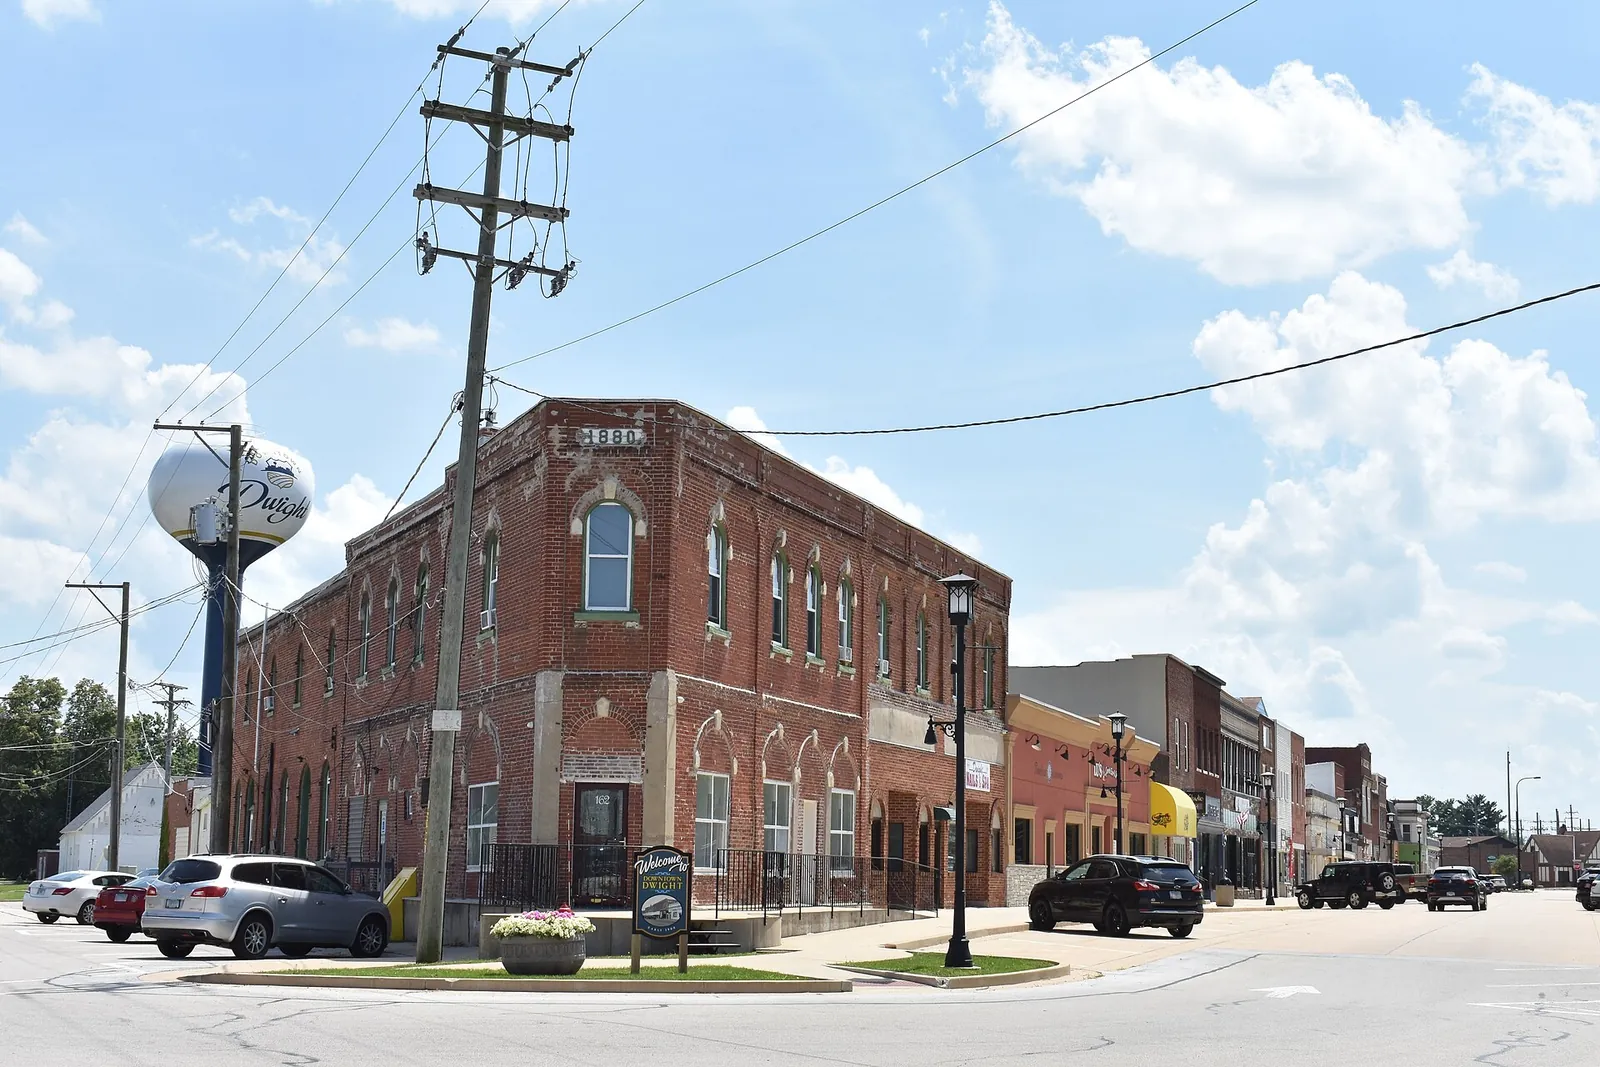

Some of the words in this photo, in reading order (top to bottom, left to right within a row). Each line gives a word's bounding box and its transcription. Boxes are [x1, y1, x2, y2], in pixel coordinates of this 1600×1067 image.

[584, 429, 636, 444] 1880
[218, 479, 311, 524] Dwight
[595, 794, 610, 805] 162
[633, 854, 682, 875] Welcome
[675, 862, 689, 873] to
[642, 881, 683, 889] DWIGHT
